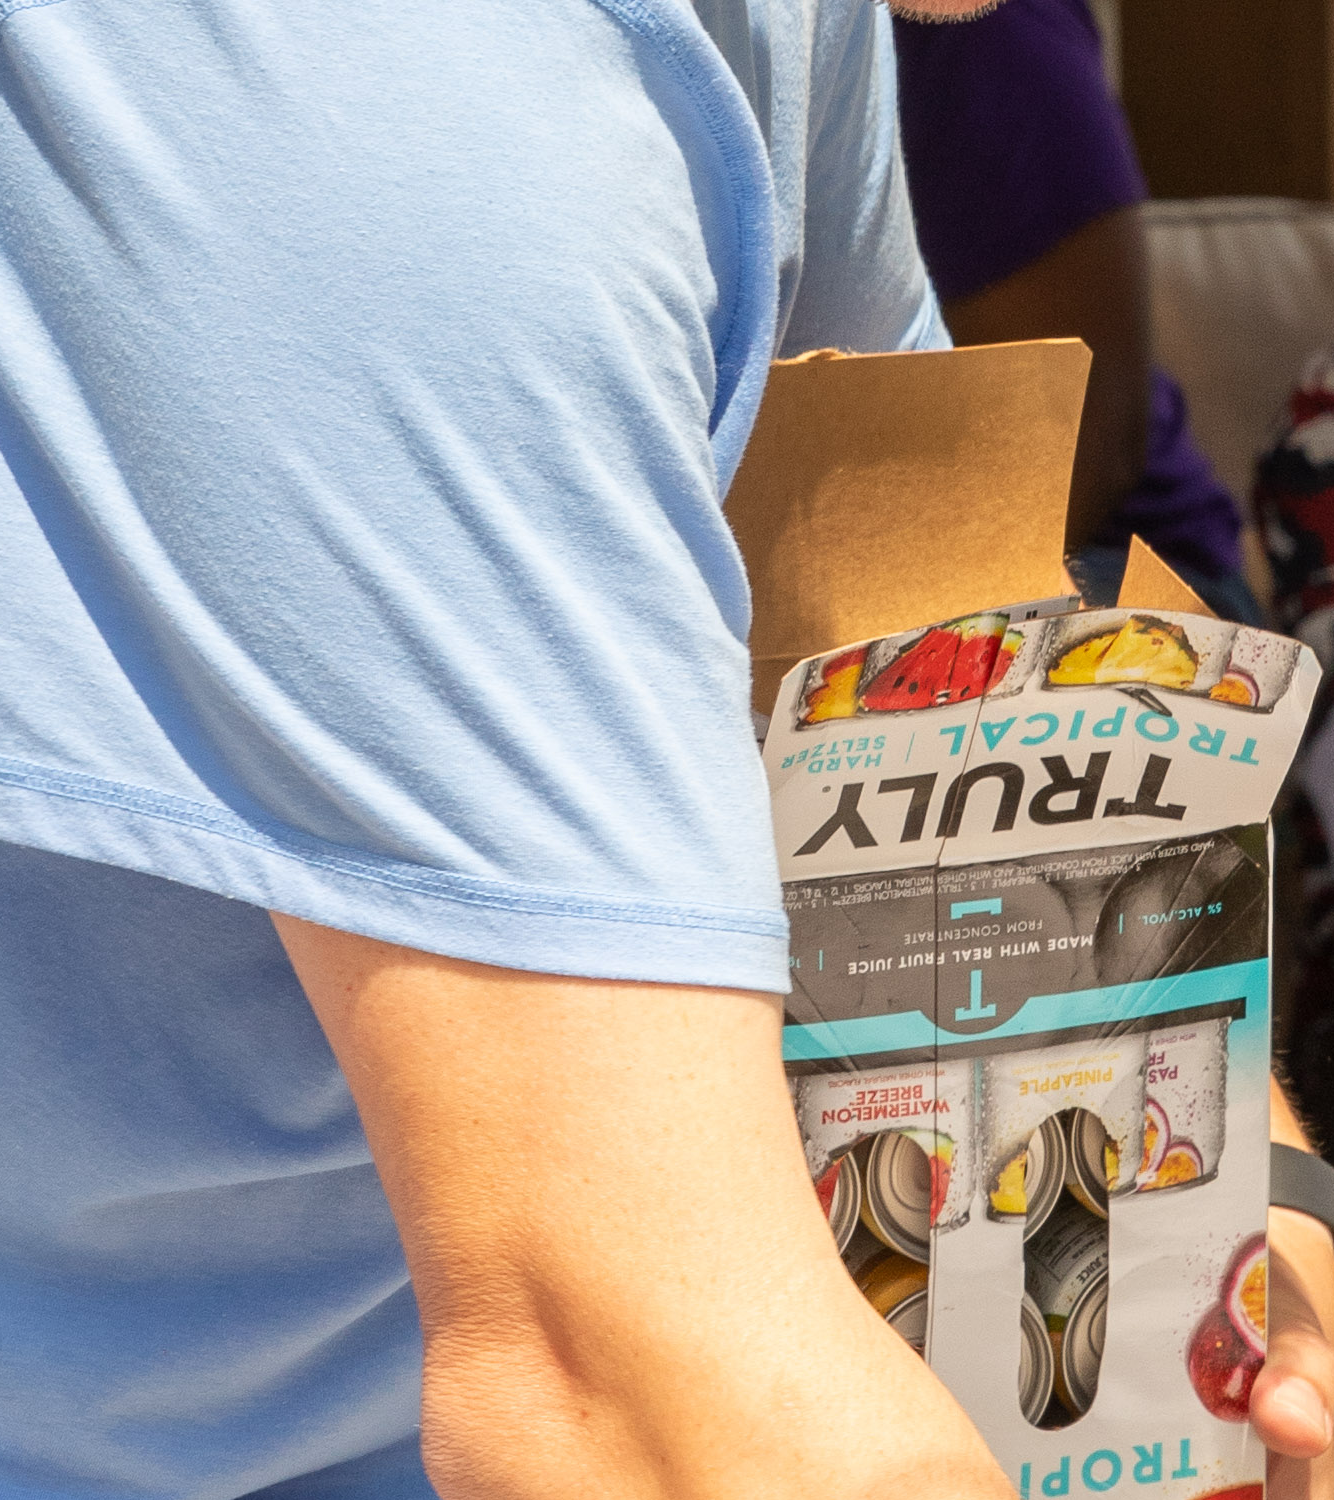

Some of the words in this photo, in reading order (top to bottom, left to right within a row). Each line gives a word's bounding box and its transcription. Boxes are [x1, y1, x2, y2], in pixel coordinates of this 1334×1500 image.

[939, 706, 1260, 766] TROPICAL
[781, 735, 887, 769] SELTZER
[807, 753, 883, 774] HARD
[1016, 860, 1080, 875] CONCENTRATE
[1081, 857, 1108, 868] FROM
[937, 871, 967, 885] OTHER
[969, 870, 992, 881] WITH
[994, 866, 1015, 878] AND
[1065, 869, 1088, 880] FRUIT
[853, 880, 893, 893] FLAVORS
[894, 876, 934, 888] NATURAL
[937, 883, 963, 894] TRULY
[991, 876, 1037, 889] PINEAPPLE
[874, 886, 934, 901] WATERMELON
[1207, 901, 1223, 916] 5%
[903, 923, 1001, 945] CONCENTRATE
[1007, 919, 1043, 937] FROM
[999, 940, 1041, 958] WITH
[1047, 933, 1094, 952] MADE
[897, 951, 945, 969] FRUIT
[952, 946, 993, 963] REAL
[847, 957, 893, 975] JUICE
[1019, 1066, 1114, 1096] PINEAPPLE
[821, 1098, 951, 1125] WATERMELON
